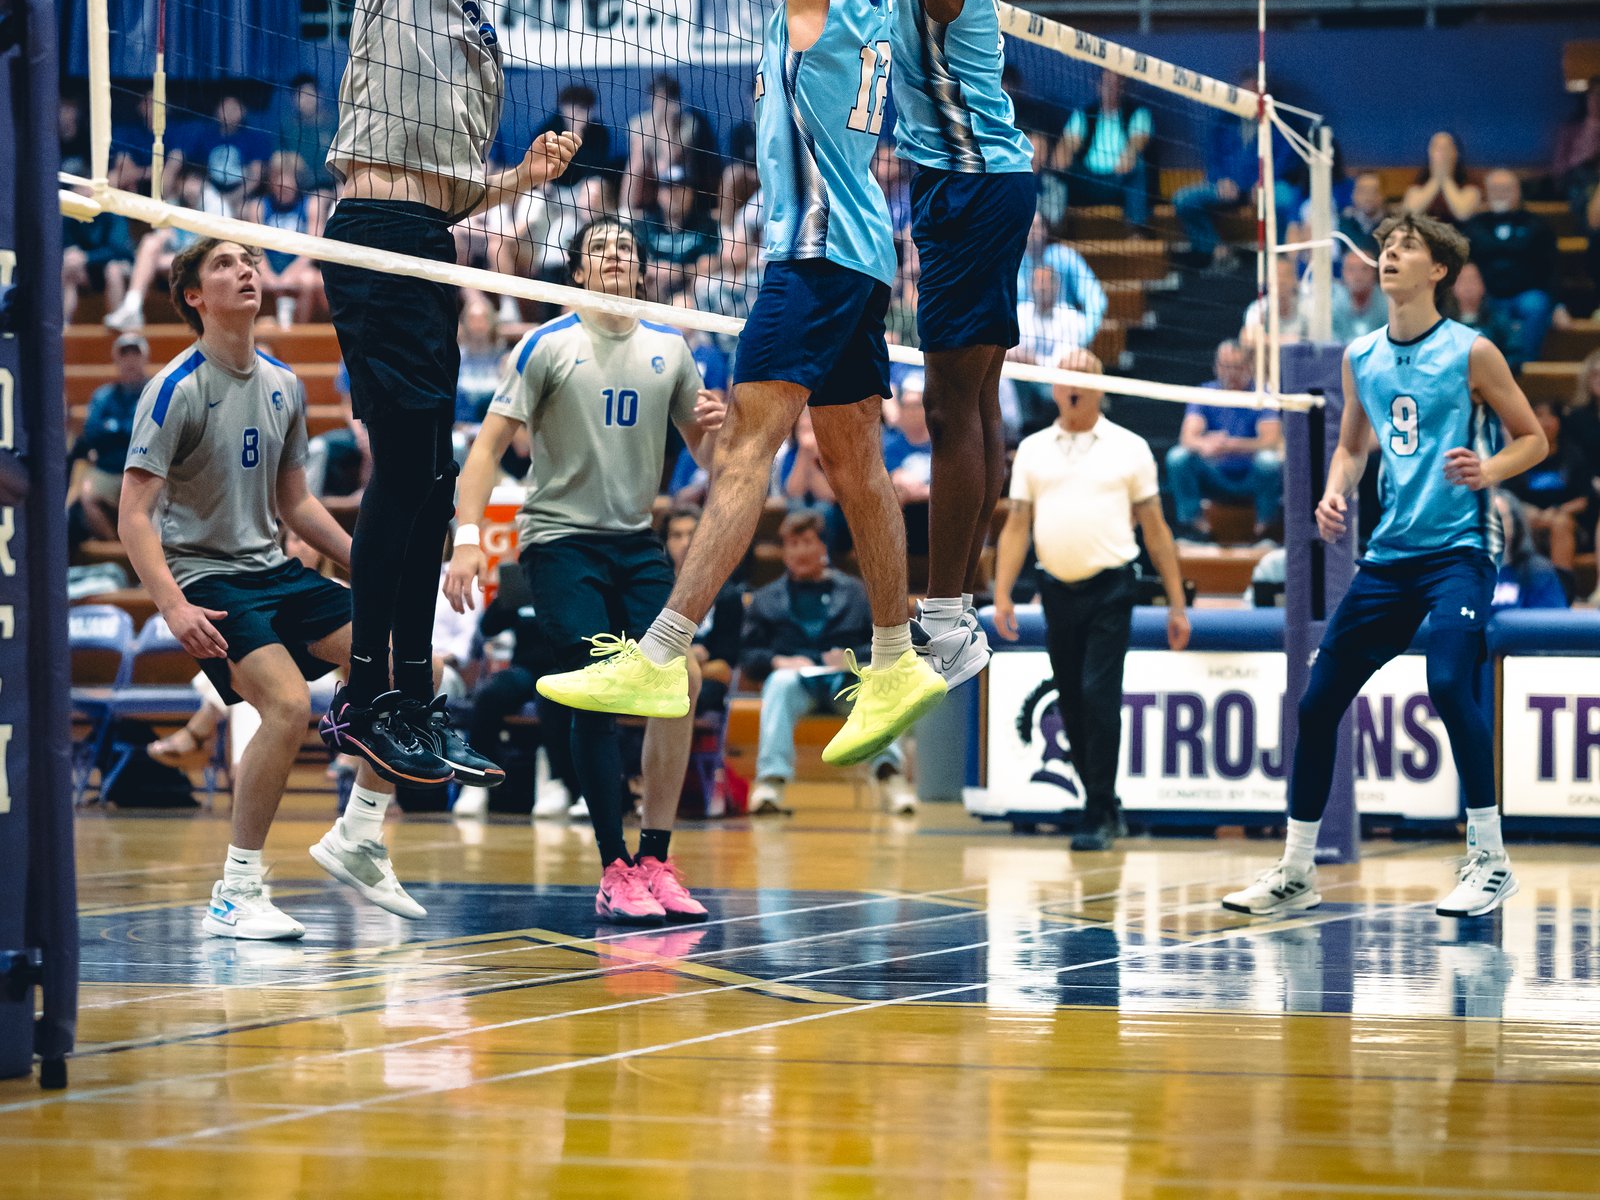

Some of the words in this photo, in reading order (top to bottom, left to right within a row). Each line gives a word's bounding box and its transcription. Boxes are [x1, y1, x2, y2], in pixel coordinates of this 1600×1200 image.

[846, 40, 893, 137] 12
[602, 388, 640, 428] 10
[1389, 393, 1421, 458] 9
[241, 427, 261, 469] 8
[1121, 689, 1442, 783] TROJNS
